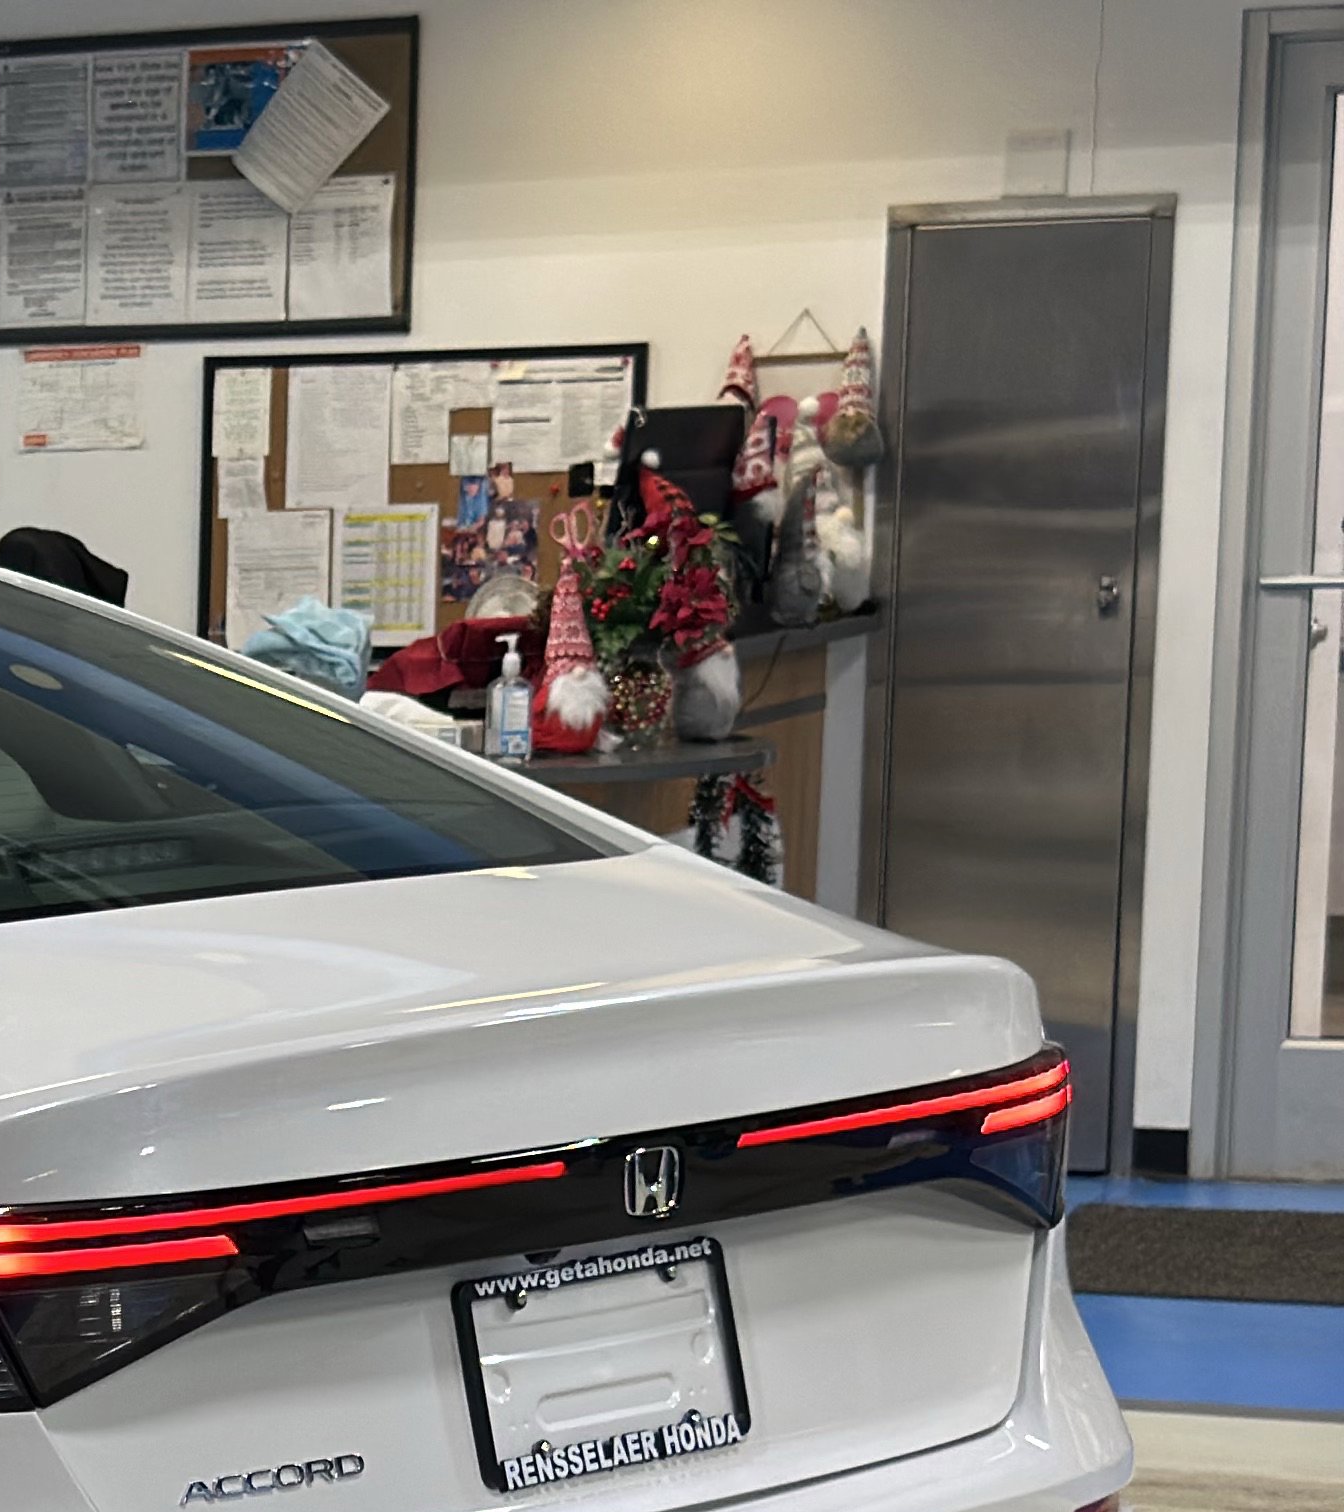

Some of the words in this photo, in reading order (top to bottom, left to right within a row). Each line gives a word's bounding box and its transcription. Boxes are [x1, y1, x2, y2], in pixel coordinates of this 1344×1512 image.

[474, 1238, 712, 1297] www.getahonda.net
[179, 1453, 365, 1509] ACCORD
[503, 1429, 659, 1491] RENSSELAER
[662, 1413, 742, 1456] HONDA
